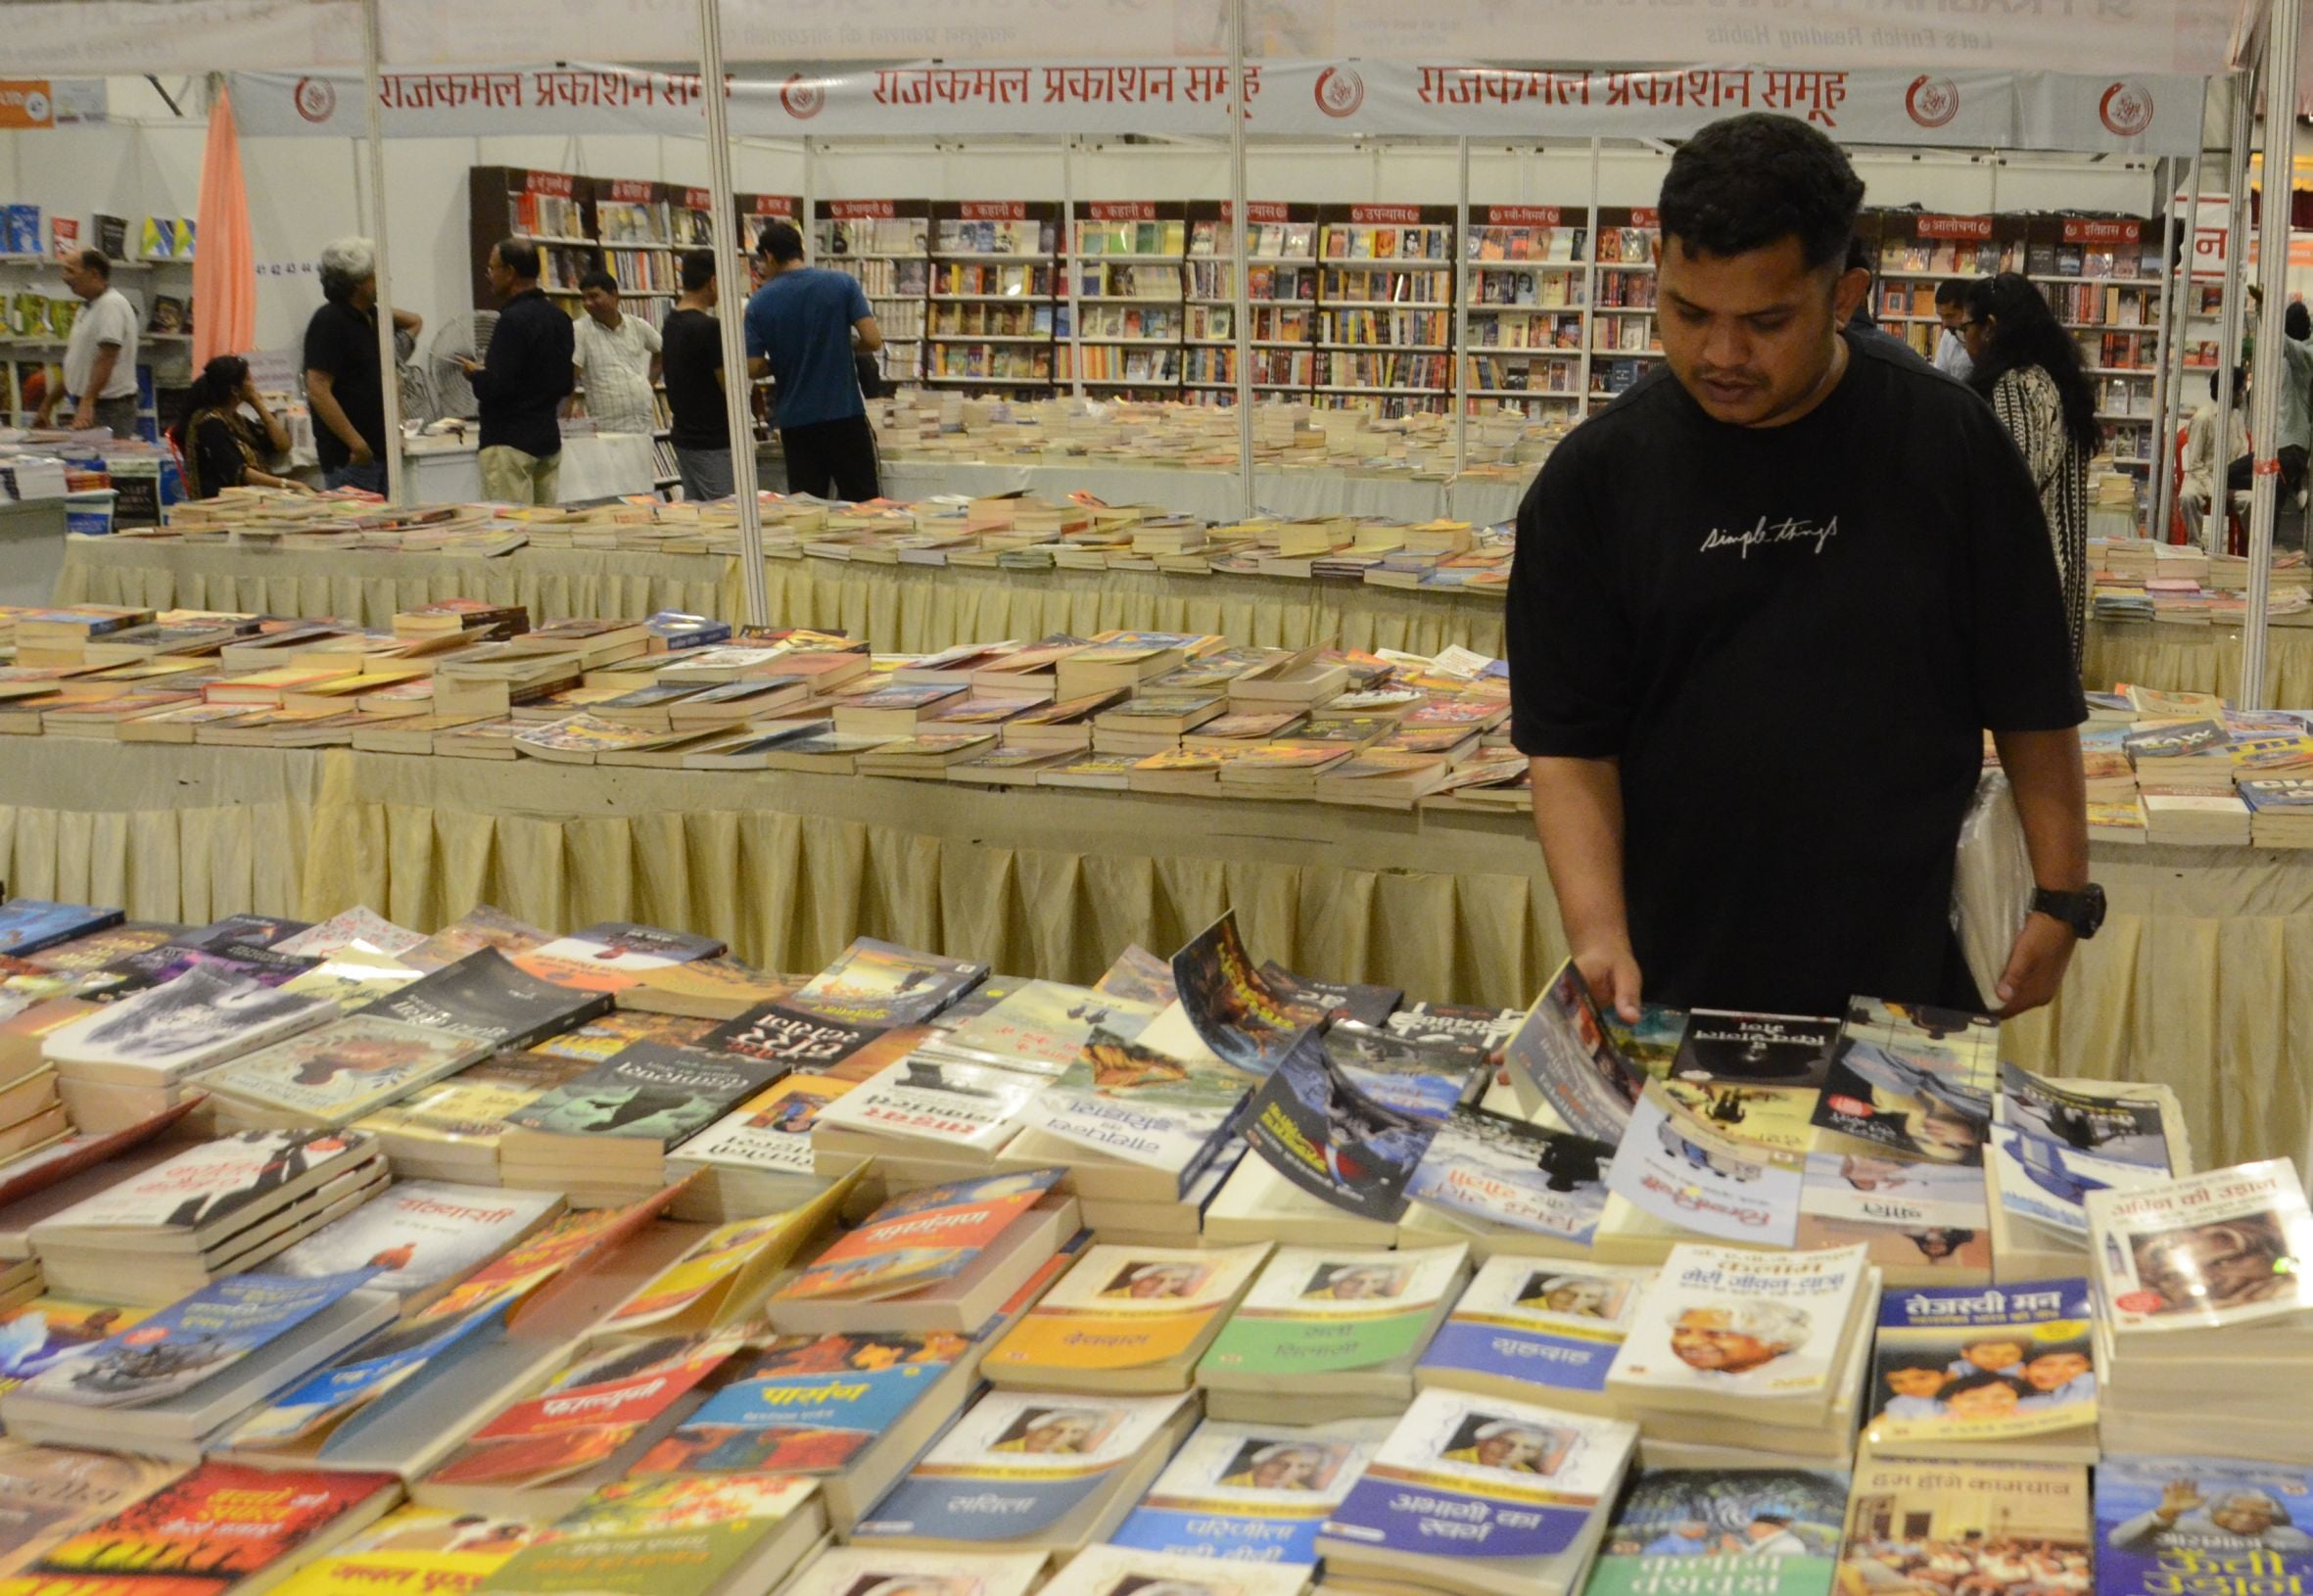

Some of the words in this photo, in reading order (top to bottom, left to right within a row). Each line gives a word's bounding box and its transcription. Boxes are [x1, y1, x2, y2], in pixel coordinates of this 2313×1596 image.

[379, 71, 523, 109] राजकमल
[533, 70, 653, 108] प्रकाशन
[873, 68, 1031, 105] राजकमल
[1043, 66, 1176, 104] प्रकाशन
[1417, 67, 1593, 107] राजकमल
[1605, 69, 1755, 109] प्रकाशन
[1763, 70, 1849, 127] समूह
[977, 200, 1009, 218] कहानी
[1109, 202, 1140, 218] कहानी
[1365, 206, 1407, 222] उपन्यास
[1932, 217, 1977, 235] आलोचना
[2084, 222, 2120, 239] इतिहास
[1699, 515, 1771, 559] simple
[1770, 515, 1838, 554] things
[2180, 1188, 2210, 1205] की
[1906, 1290, 2007, 1318] तेजस्वी
[2014, 1290, 2061, 1312] मन
[1871, 1472, 1912, 1488] हम
[1916, 1472, 1962, 1491] होंगे
[1389, 1493, 1489, 1526] अभागी
[1495, 1508, 1543, 1530] का
[1418, 1516, 1495, 1544] स्वर्ग
